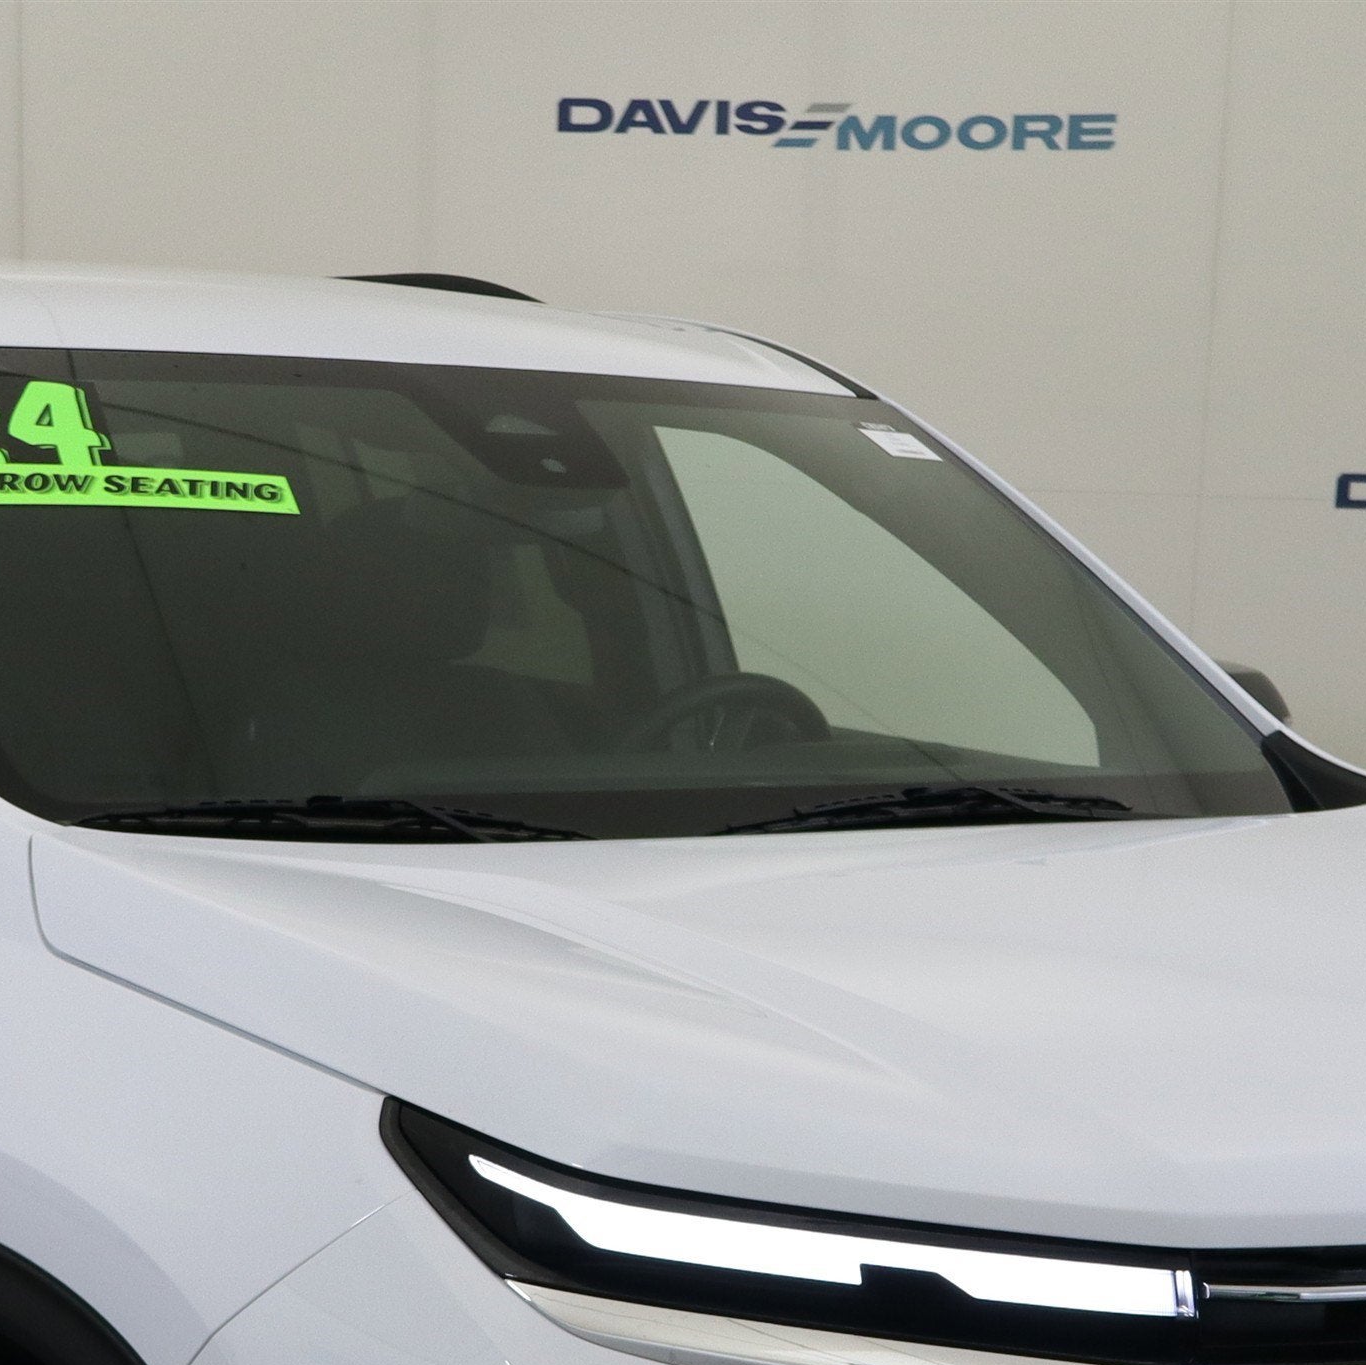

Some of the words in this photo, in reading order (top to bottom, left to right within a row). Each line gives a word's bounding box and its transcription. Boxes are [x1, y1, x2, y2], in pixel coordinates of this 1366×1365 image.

[557, 97, 788, 136] DAVIS
[835, 113, 1118, 152] MOORE
[104, 473, 284, 503] SEATING
